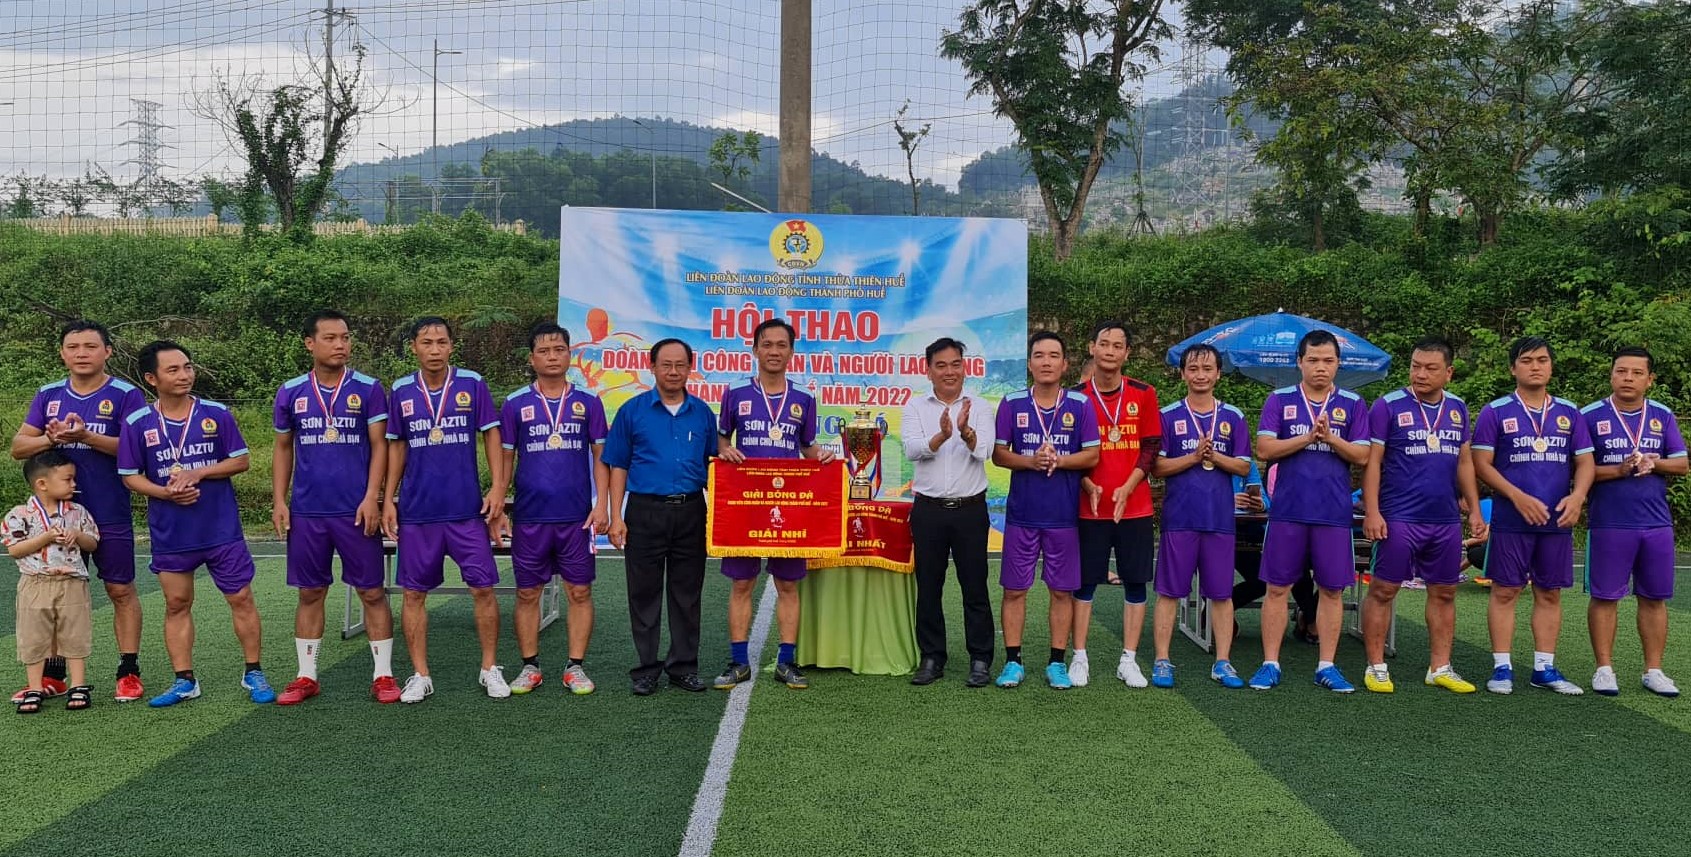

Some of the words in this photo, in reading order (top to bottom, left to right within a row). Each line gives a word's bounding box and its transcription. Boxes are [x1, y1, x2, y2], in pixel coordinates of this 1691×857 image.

[686, 272, 707, 283] LIÊN
[709, 271, 739, 284] ĐOÀN
[742, 274, 761, 284] LAO
[764, 272, 795, 286] ĐỘNG
[797, 272, 821, 285] TỈNH
[824, 274, 850, 286] THỪA
[853, 275, 882, 287] THIÊN
[884, 272, 905, 287] HUẾ
[705, 285, 726, 295] LIÊN
[727, 285, 755, 296] ĐOÀN
[757, 287, 776, 296] LAO
[778, 286, 807, 299] ĐỘNG
[809, 286, 841, 298] THÀNH
[843, 286, 864, 298] PHỐ
[866, 285, 886, 298] HUẾ
[786, 310, 880, 342] THAO
[602, 348, 651, 371] ĐOÀN
[703, 348, 752, 372] CÔNG
[810, 350, 835, 374] VÀ
[839, 350, 894, 375] NGƯỜI
[963, 356, 986, 377] NG
[821, 382, 860, 405] NĂM
[866, 386, 912, 406] 2022
[301, 417, 322, 429] SƠN
[409, 420, 431, 432] SƠN
[744, 419, 765, 432] SƠN
[529, 424, 550, 436] SƠN
[1023, 433, 1040, 444] SƠN
[1605, 436, 1627, 448] SƠN
[184, 442, 214, 457] LAZTU
[748, 529, 777, 538] GIẢI
